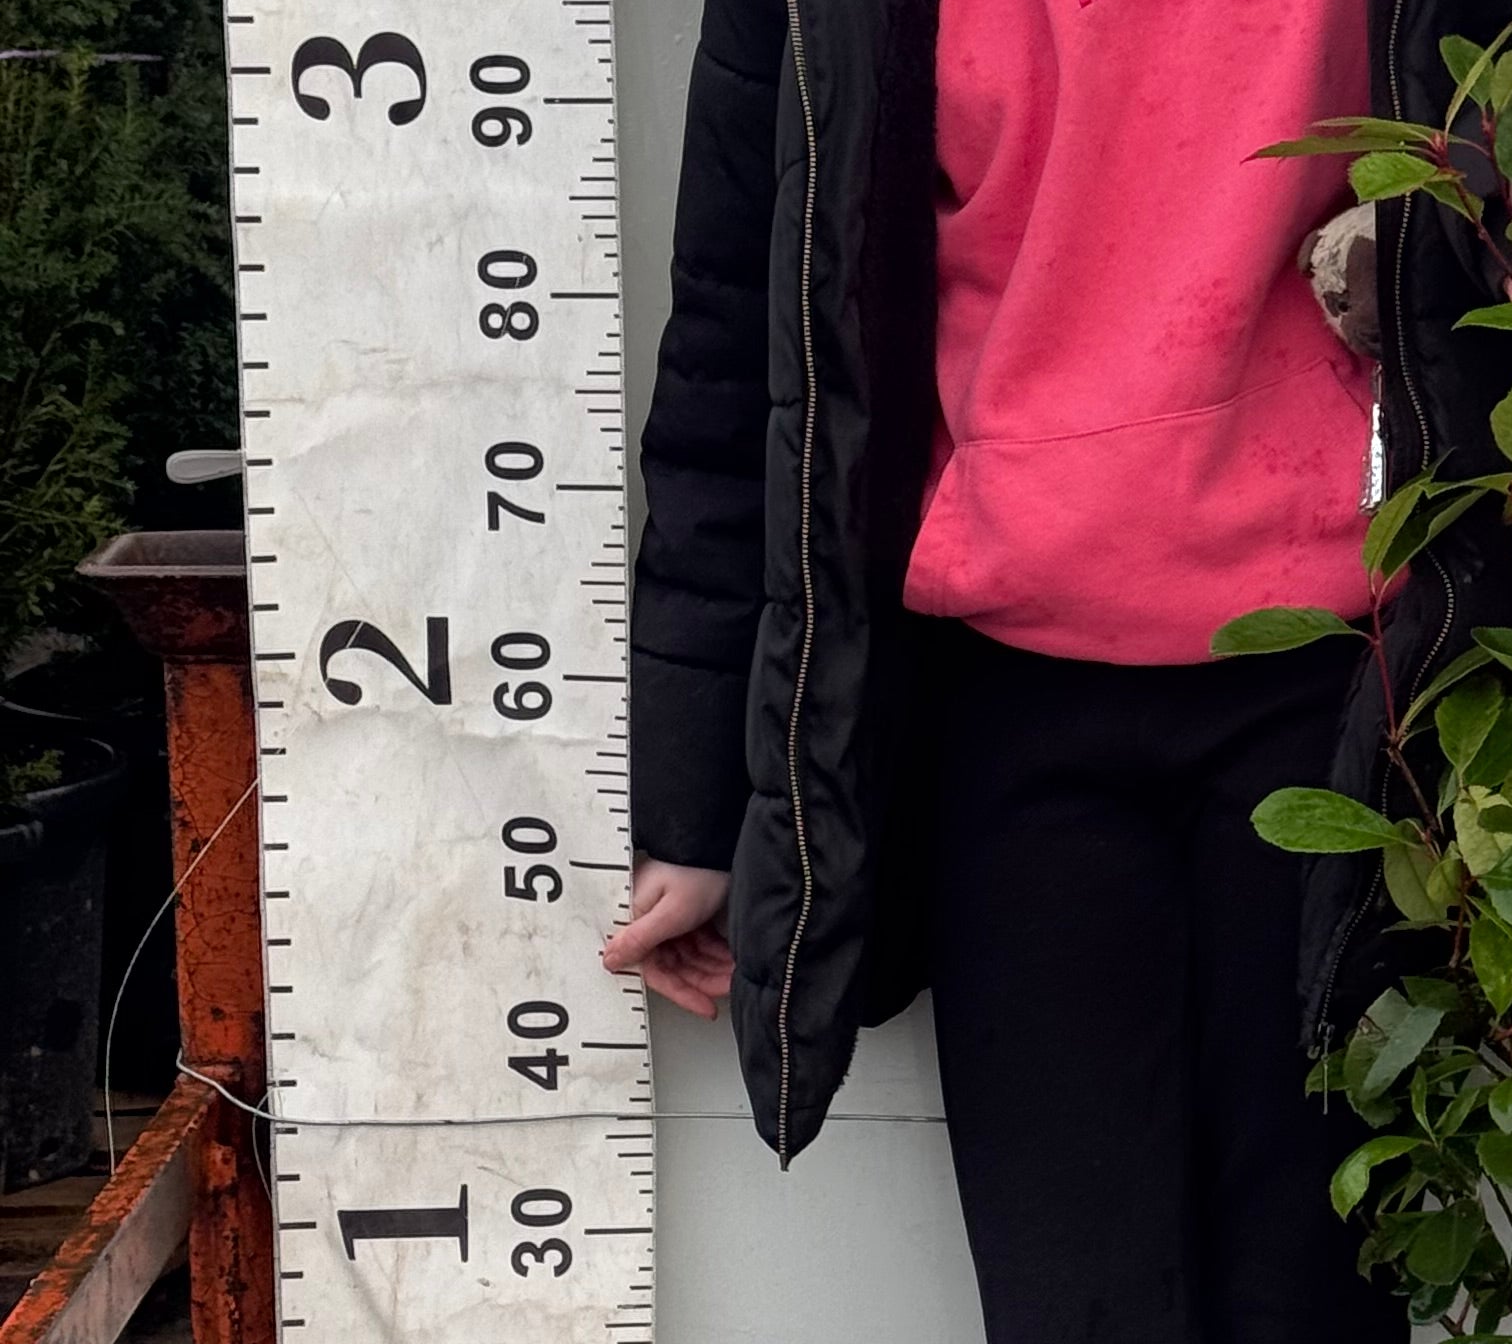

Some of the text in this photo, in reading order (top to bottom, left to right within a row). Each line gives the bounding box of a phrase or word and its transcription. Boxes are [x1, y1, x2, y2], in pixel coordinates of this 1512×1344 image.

[291, 31, 427, 126] 3
[469, 54, 533, 148] 90
[477, 249, 540, 341] 80
[484, 441, 546, 531] 70
[319, 616, 452, 706] 2
[490, 632, 553, 721] 60
[501, 816, 563, 903] 50
[507, 1000, 570, 1091] 40
[337, 1183, 469, 1263] 1
[510, 1188, 573, 1278] 30
